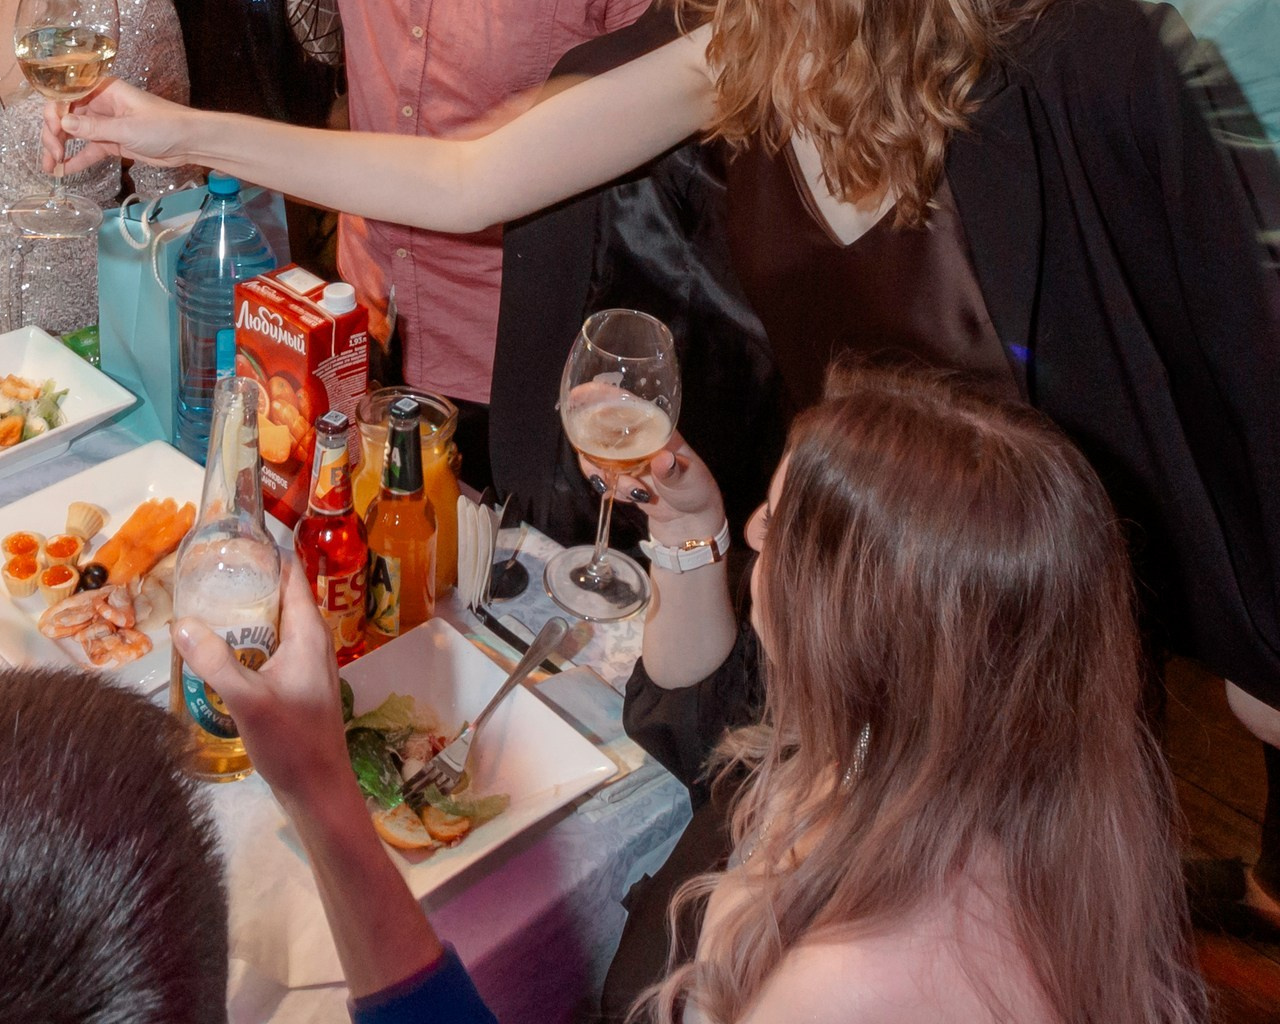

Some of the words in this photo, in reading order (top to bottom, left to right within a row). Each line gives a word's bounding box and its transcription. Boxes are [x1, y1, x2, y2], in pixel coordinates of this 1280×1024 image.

[235, 300, 307, 356] Любимый
[261, 466, 288, 489] СИНОВОЕ
[196, 698, 233, 727] CERVEZ
